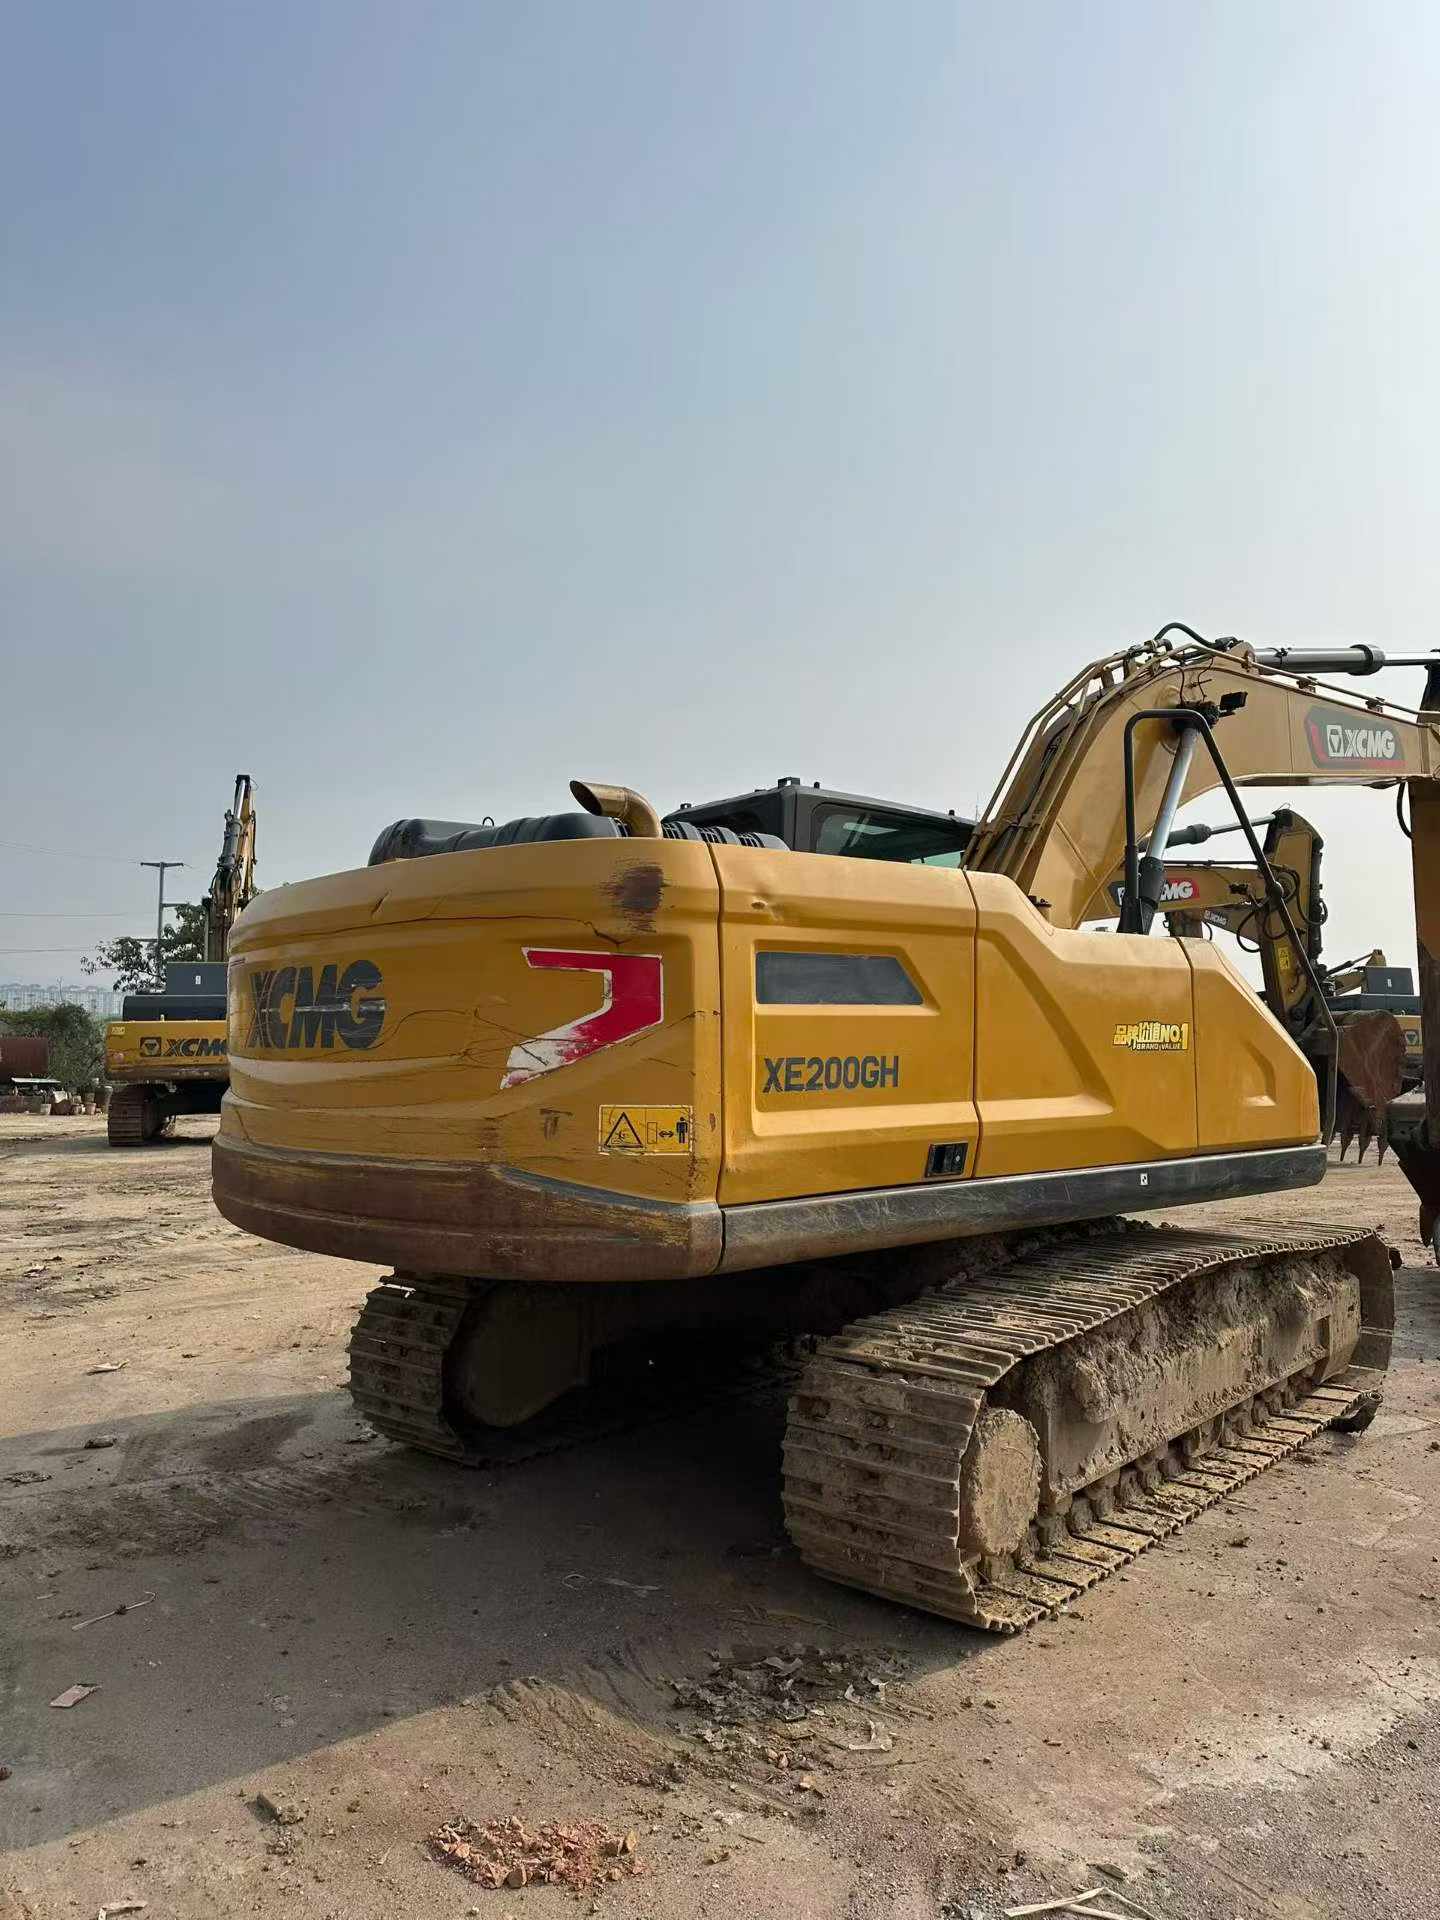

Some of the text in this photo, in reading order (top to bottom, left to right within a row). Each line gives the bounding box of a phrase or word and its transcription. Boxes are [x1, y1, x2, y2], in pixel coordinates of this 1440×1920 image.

[1344, 729, 1395, 758] XCMG
[1160, 881, 1194, 901] MG
[244, 959, 386, 1049] XCMG
[762, 1055, 899, 1093] XE200GH
